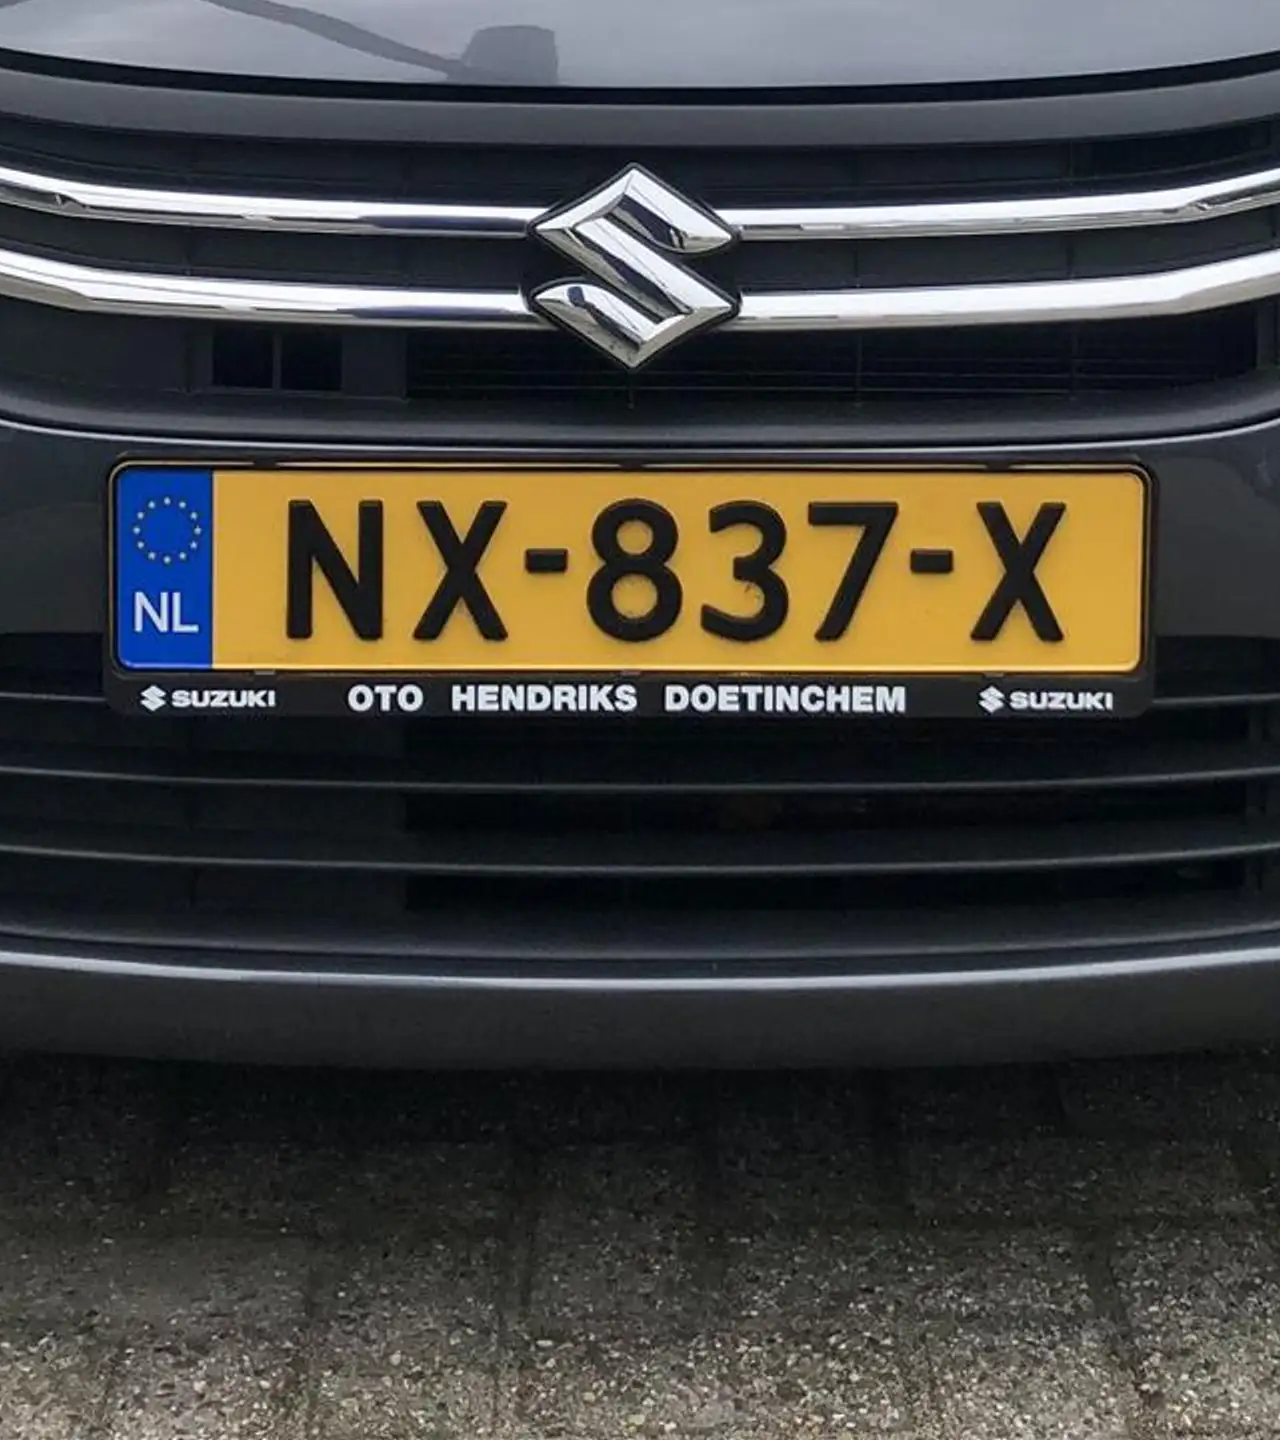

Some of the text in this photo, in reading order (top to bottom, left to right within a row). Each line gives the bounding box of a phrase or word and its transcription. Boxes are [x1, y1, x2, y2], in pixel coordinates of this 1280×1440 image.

[285, 498, 1066, 644] NX-837-X
[133, 591, 199, 634] NL
[171, 689, 276, 709] SUZUKI
[347, 684, 906, 714] OTO HENDRIKS DOETINCHEM
[1009, 691, 1113, 711] SUZUKI
